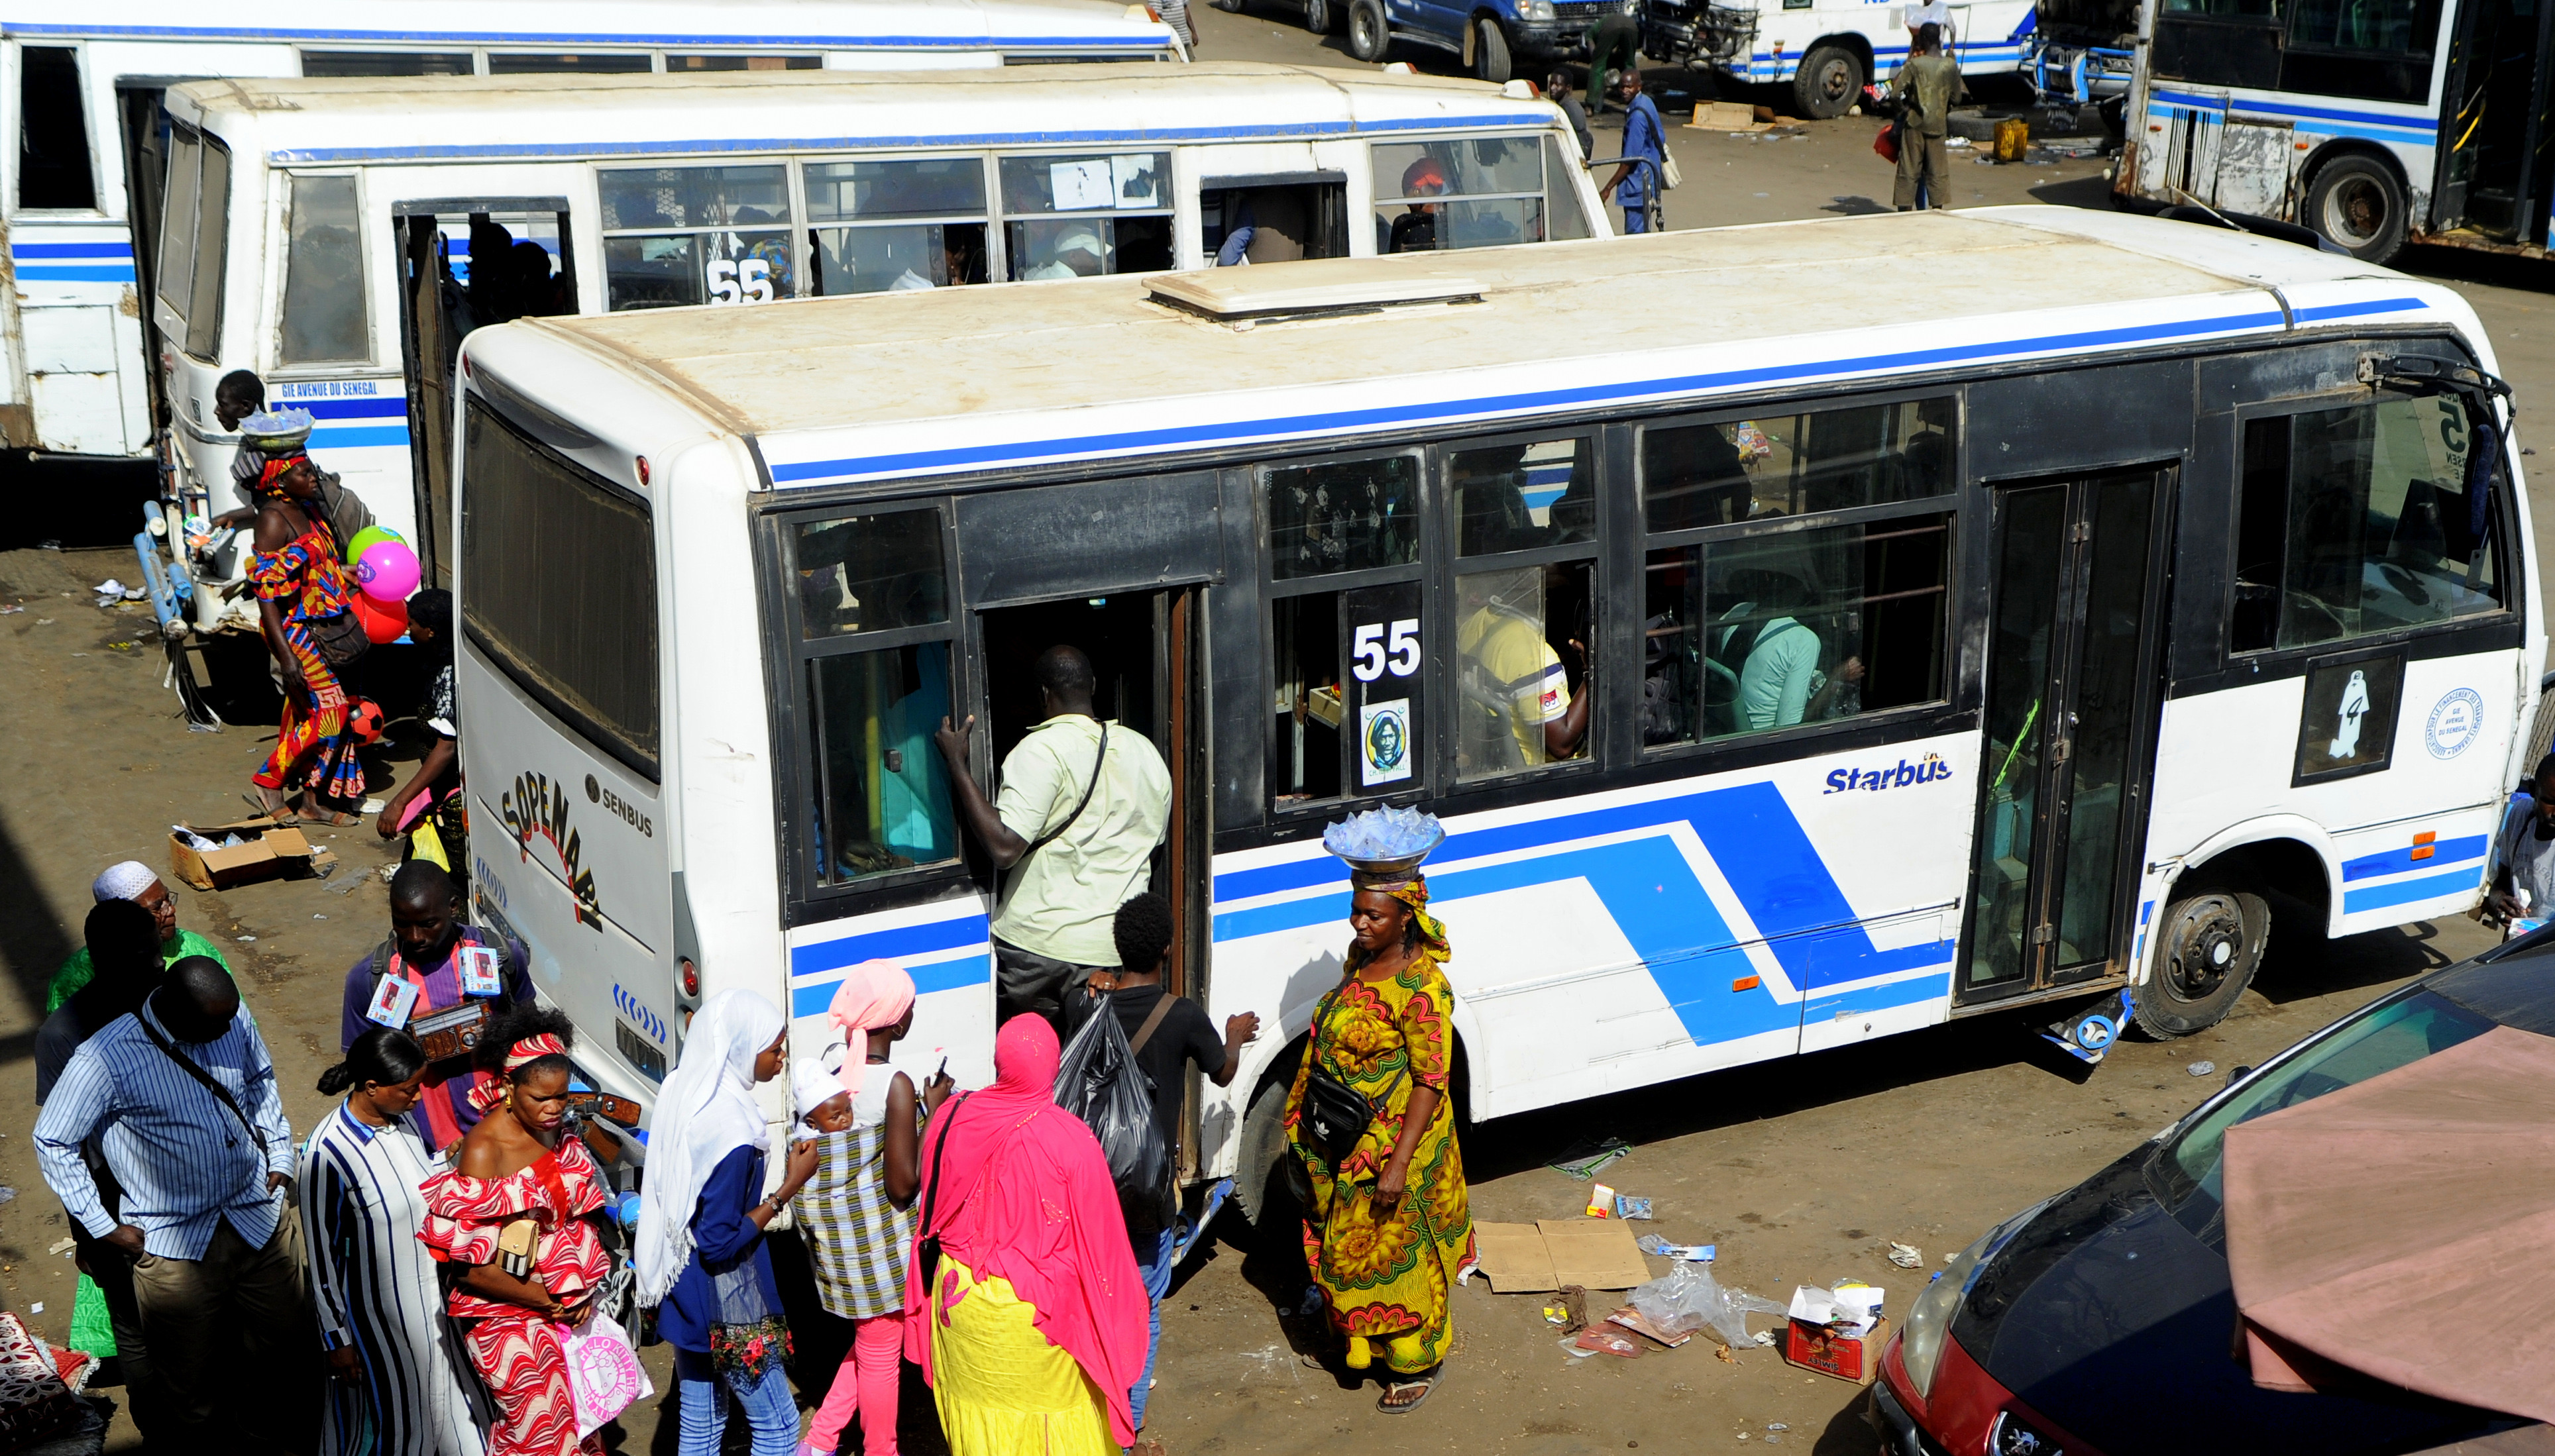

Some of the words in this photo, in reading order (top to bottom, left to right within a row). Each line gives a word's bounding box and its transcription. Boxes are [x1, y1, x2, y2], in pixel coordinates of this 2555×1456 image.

[706, 259, 774, 306] 55
[282, 384, 296, 397] GIE
[298, 382, 328, 397] AVENUE
[329, 382, 341, 395] DU
[343, 381, 377, 395] SENEGAL
[1353, 618, 1421, 682] 55
[2446, 725, 2467, 734] SENEGAL
[1823, 759, 1953, 795] Starbus
[603, 788, 653, 838] SENBUS
[613, 1343, 635, 1372] KITTY
